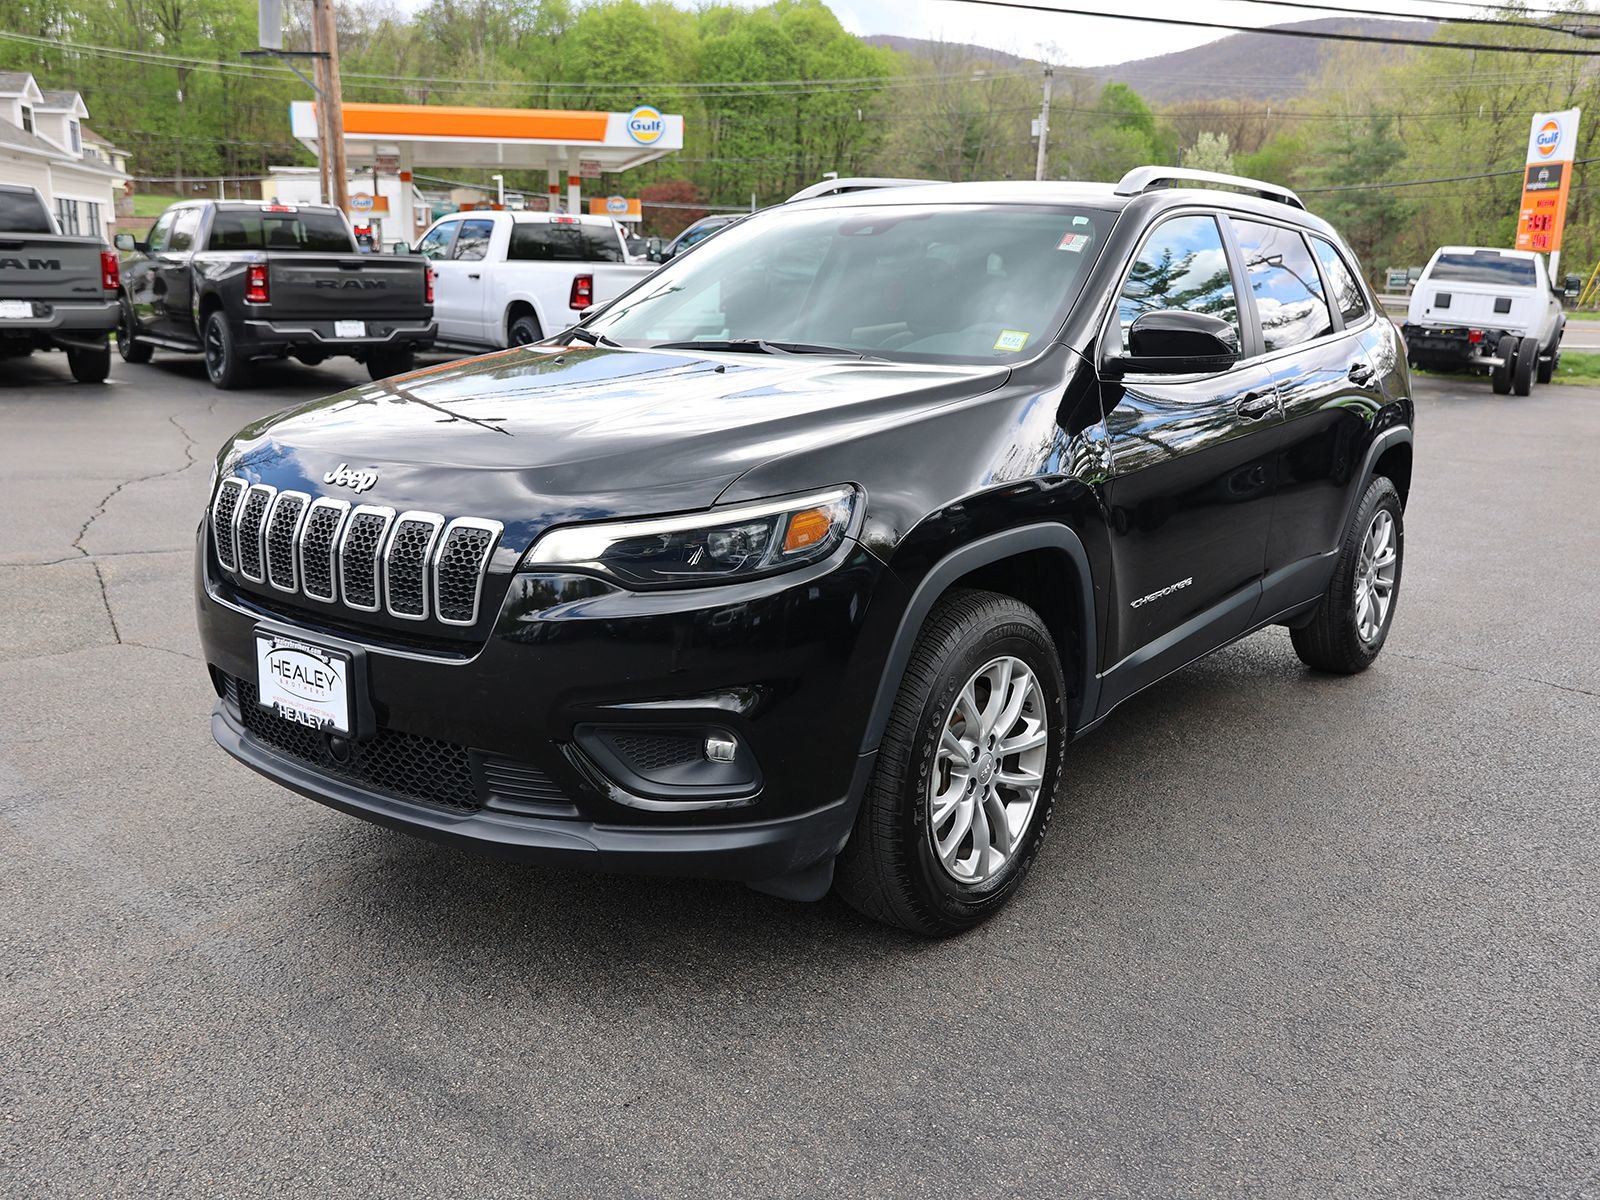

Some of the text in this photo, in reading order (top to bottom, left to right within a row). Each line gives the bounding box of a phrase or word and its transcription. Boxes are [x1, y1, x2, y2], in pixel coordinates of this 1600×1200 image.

[630, 119, 661, 131] Gulf
[1536, 131, 1559, 146] Gulf
[352, 199, 372, 207] Gulf
[0, 258, 61, 270] AM
[315, 278, 386, 289] RAM
[323, 463, 378, 494] Jeep
[1130, 577, 1193, 609] CHEROKEE
[271, 657, 335, 692] HEALEY
[279, 678, 325, 697] BROTHERS
[279, 705, 324, 731] HEALEY
